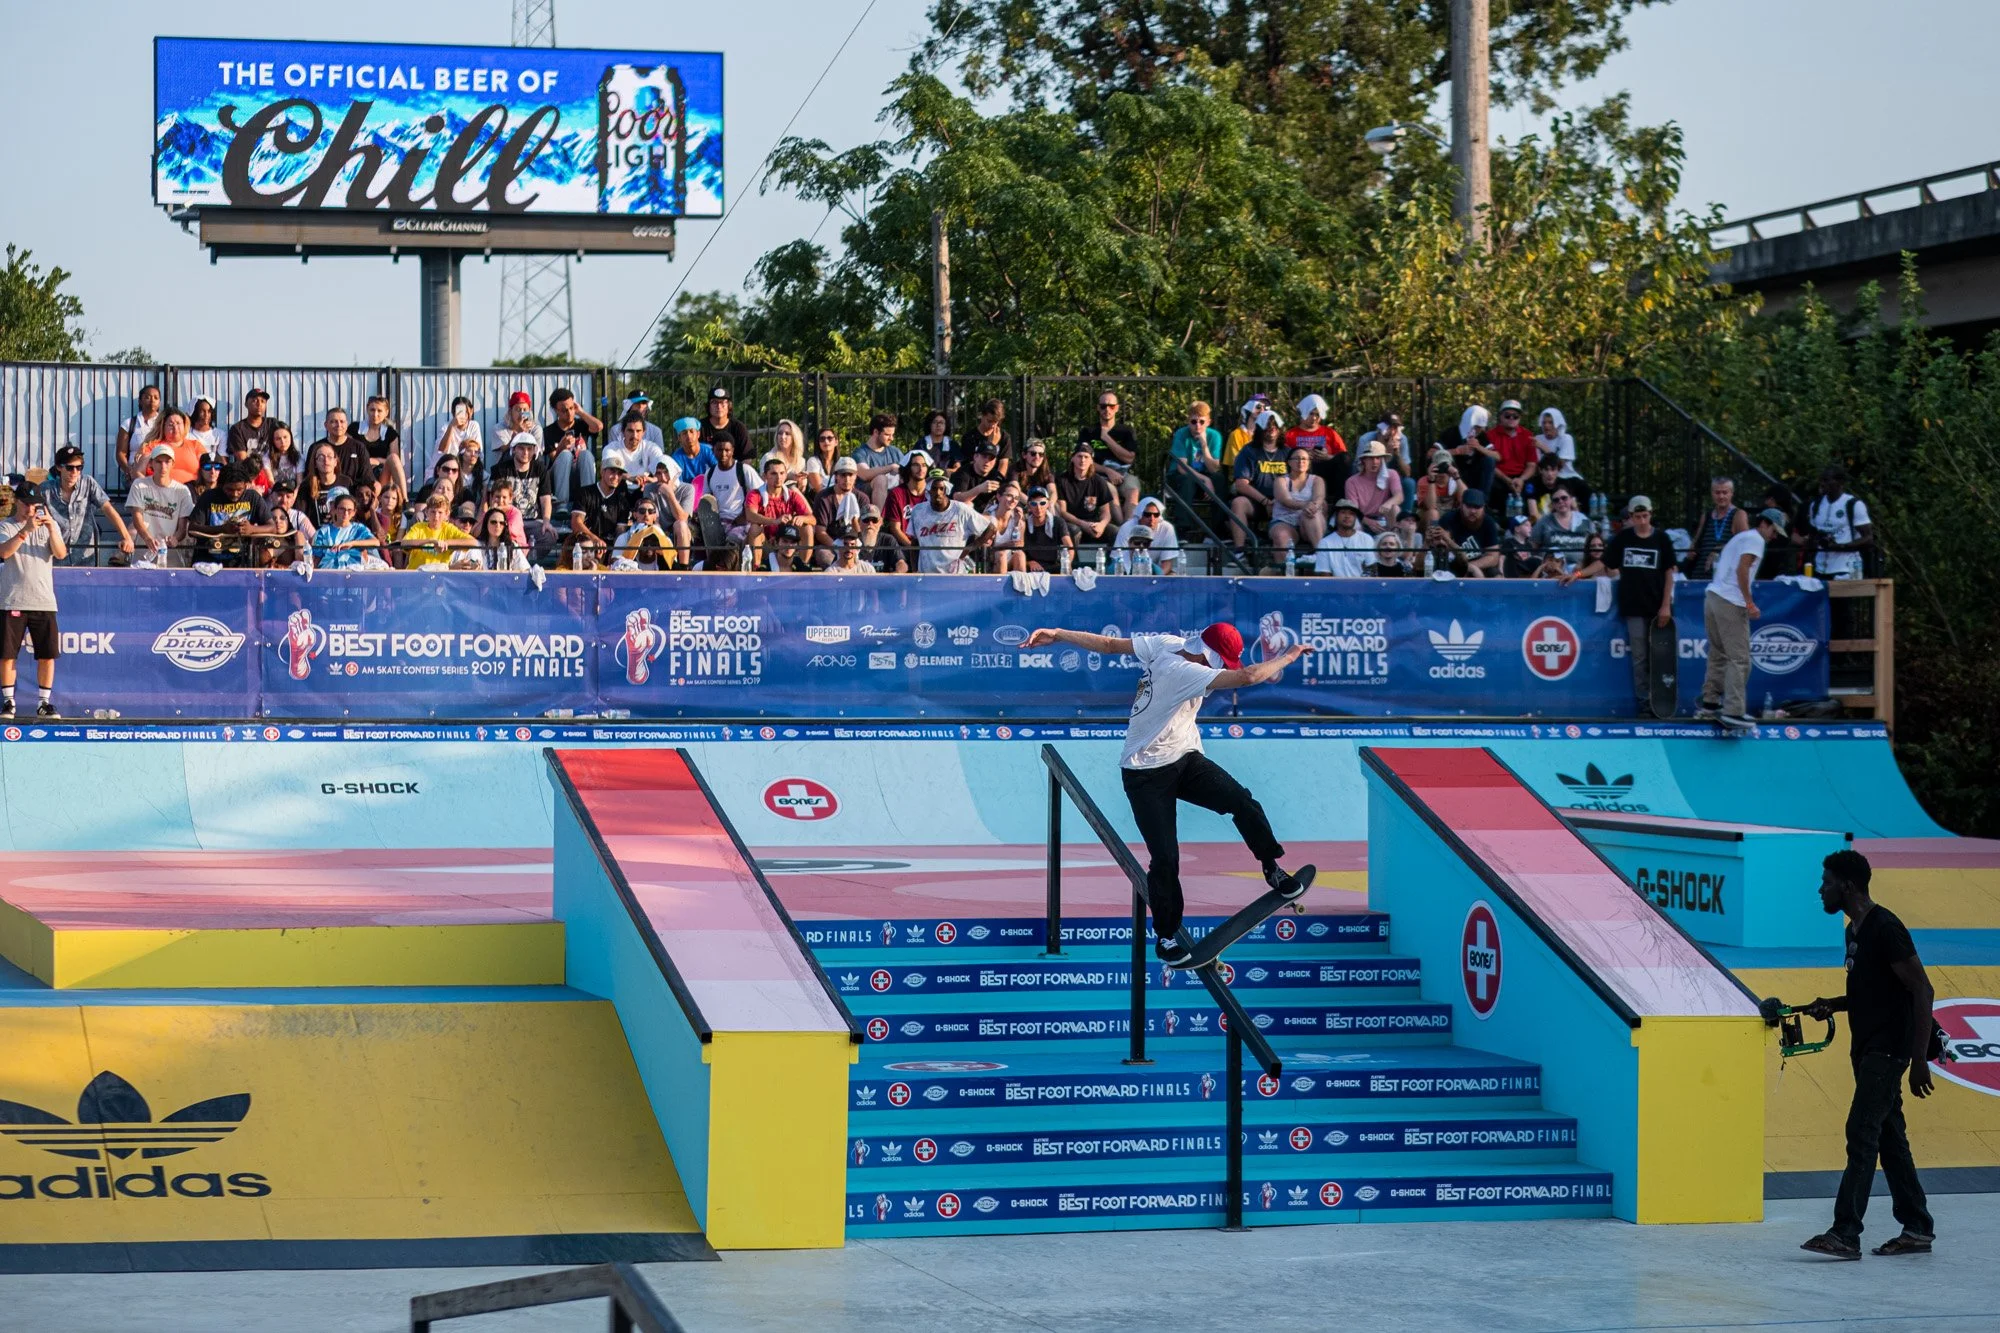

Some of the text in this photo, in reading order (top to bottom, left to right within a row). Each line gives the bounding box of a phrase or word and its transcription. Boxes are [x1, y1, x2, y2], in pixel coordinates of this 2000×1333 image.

[218, 61, 558, 94] THE OFFICIAL BEER OF
[217, 98, 560, 212] Chill
[607, 144, 677, 168] IGH
[670, 616, 761, 633] BEST FOOT
[948, 625, 979, 638] MOB
[1302, 618, 1386, 635] BEST FOOT
[808, 628, 848, 639] UPPERCUT
[164, 638, 234, 649] Dickies
[330, 633, 584, 658] BEST FOOT FORWARD
[670, 634, 762, 652] FORWARD
[953, 638, 972, 646] GRIP
[1302, 636, 1387, 652] FORWARD
[1536, 644, 1566, 653] BONES
[1750, 643, 1808, 654] Dickies
[670, 652, 762, 676] FINALS
[920, 654, 963, 666] ELEMENT
[972, 654, 1012, 668] BAKER
[1019, 654, 1053, 668] DGK
[1302, 652, 1388, 676] FINALS
[362, 658, 584, 677] AM SKATE CONTEST SERIES 2019 FINALS
[1429, 663, 1486, 678] adidas
[742, 677, 760, 685] 2019
[320, 782, 420, 794] G-SHOCK
[778, 798, 822, 806] BONES
[1570, 801, 1649, 813] adidas
[1637, 868, 1726, 915] G-SHOCK
[826, 930, 872, 943] FINALS
[1000, 928, 1033, 936] G-SHOCK
[1076, 928, 1107, 939] FOOT
[1470, 953, 1494, 970] BONES
[980, 972, 1151, 986] BEST FOOT FORWARD FINS
[1278, 970, 1310, 978] G-SHOCK
[1320, 970, 1348, 981] BEST
[1349, 970, 1380, 981] FOOT
[935, 1024, 969, 1032] G-SHOCK
[979, 1020, 1154, 1035] BEST FOOT FORWARD FINS
[1326, 1015, 1448, 1029] BEST FOOT FORWARD
[1326, 1080, 1360, 1088] G-SHOCK
[1370, 1077, 1540, 1092] BEST FOOT FORWARD FINAL
[960, 1088, 995, 1096] G-SHOCK
[1006, 1083, 1190, 1100] BEST FOOT FORWARD FINALS
[1404, 1129, 1576, 1145] BEST FOOT FORWARD FINAL
[986, 1144, 1023, 1152] G-SHOCK
[1034, 1137, 1220, 1155] BEST FOOT FORWARD FINALS
[0, 1165, 272, 1200] adidas
[1436, 1184, 1611, 1200] BEST FOOT FORWARD FINAL
[1011, 1199, 1048, 1207] G-SHOCK
[1059, 1193, 1250, 1211] BEST FOOT FORWARD FINS
